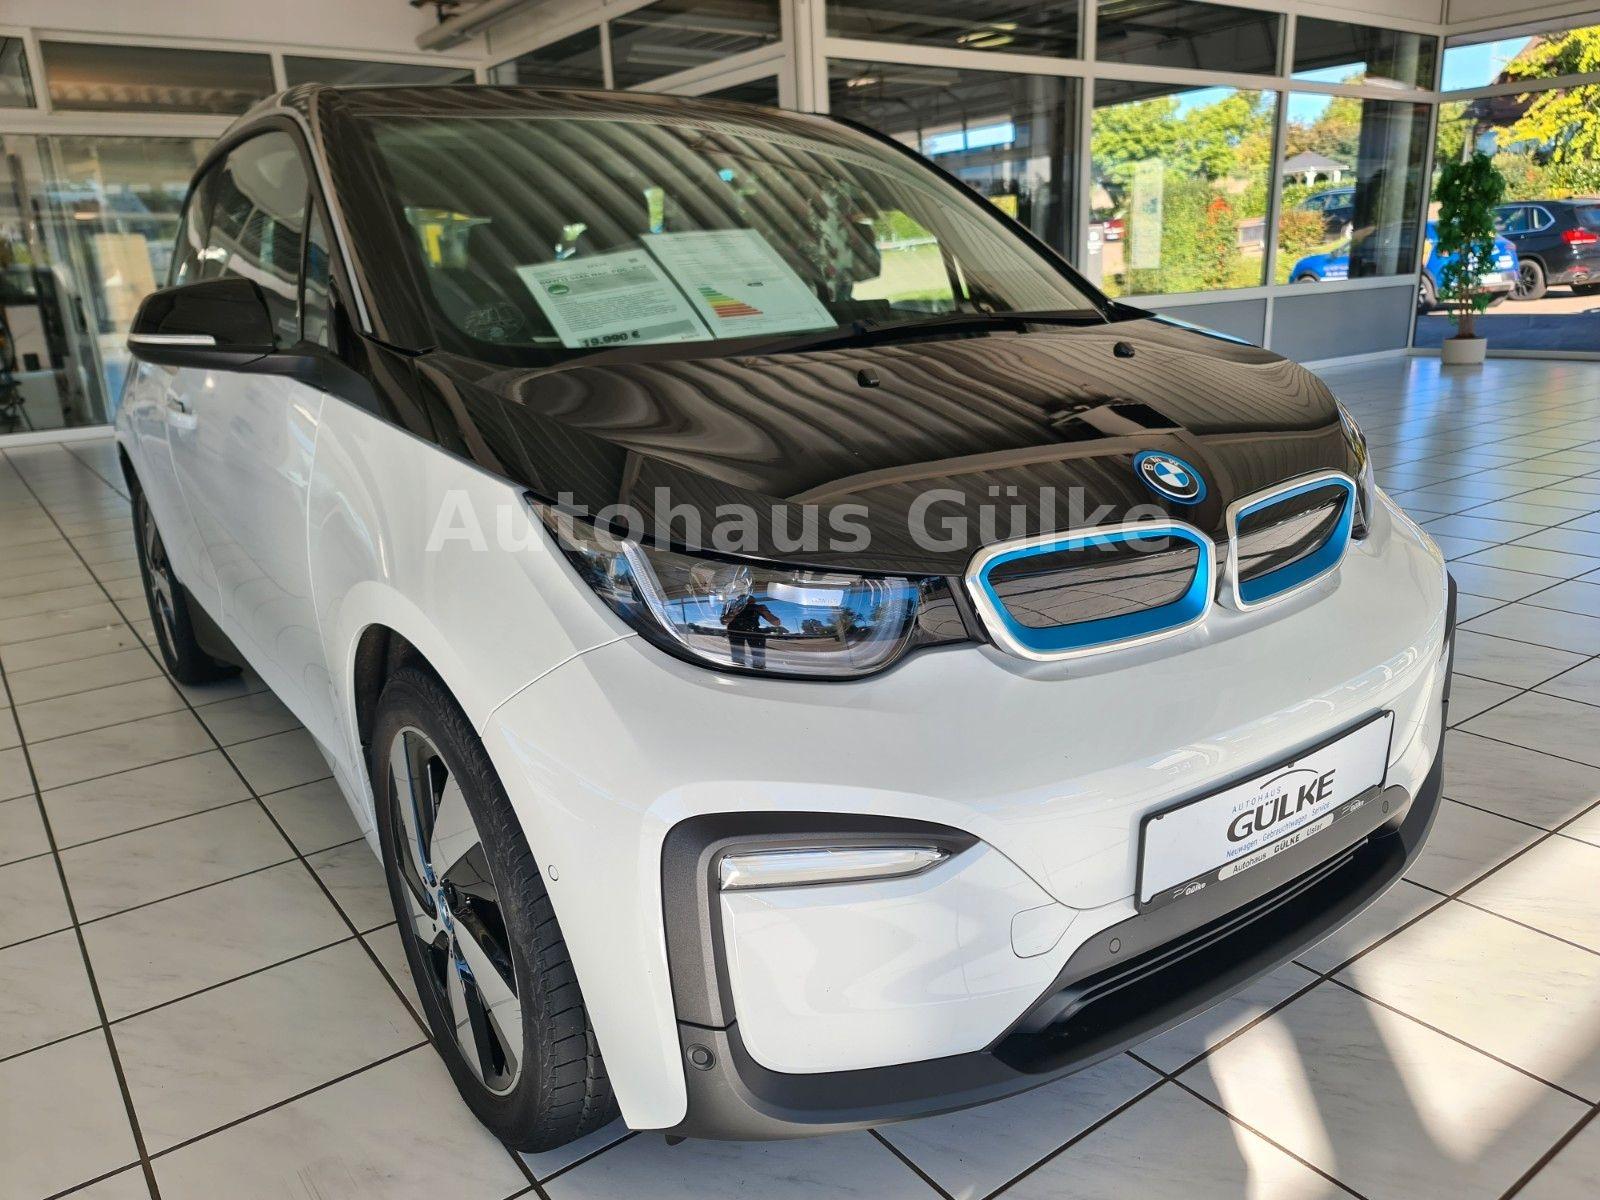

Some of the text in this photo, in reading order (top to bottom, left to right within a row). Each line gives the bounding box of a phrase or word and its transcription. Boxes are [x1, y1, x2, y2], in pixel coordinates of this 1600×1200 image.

[582, 329, 641, 348] 19.990 €
[1227, 769, 1336, 842] GÜLKE
[1232, 786, 1282, 814] AUTOHAUS
[1226, 801, 1330, 858] Neuwagen Gebrauchtwagen Service
[1232, 852, 1267, 874] Autohaus
[1273, 833, 1301, 854] GÜLKE
